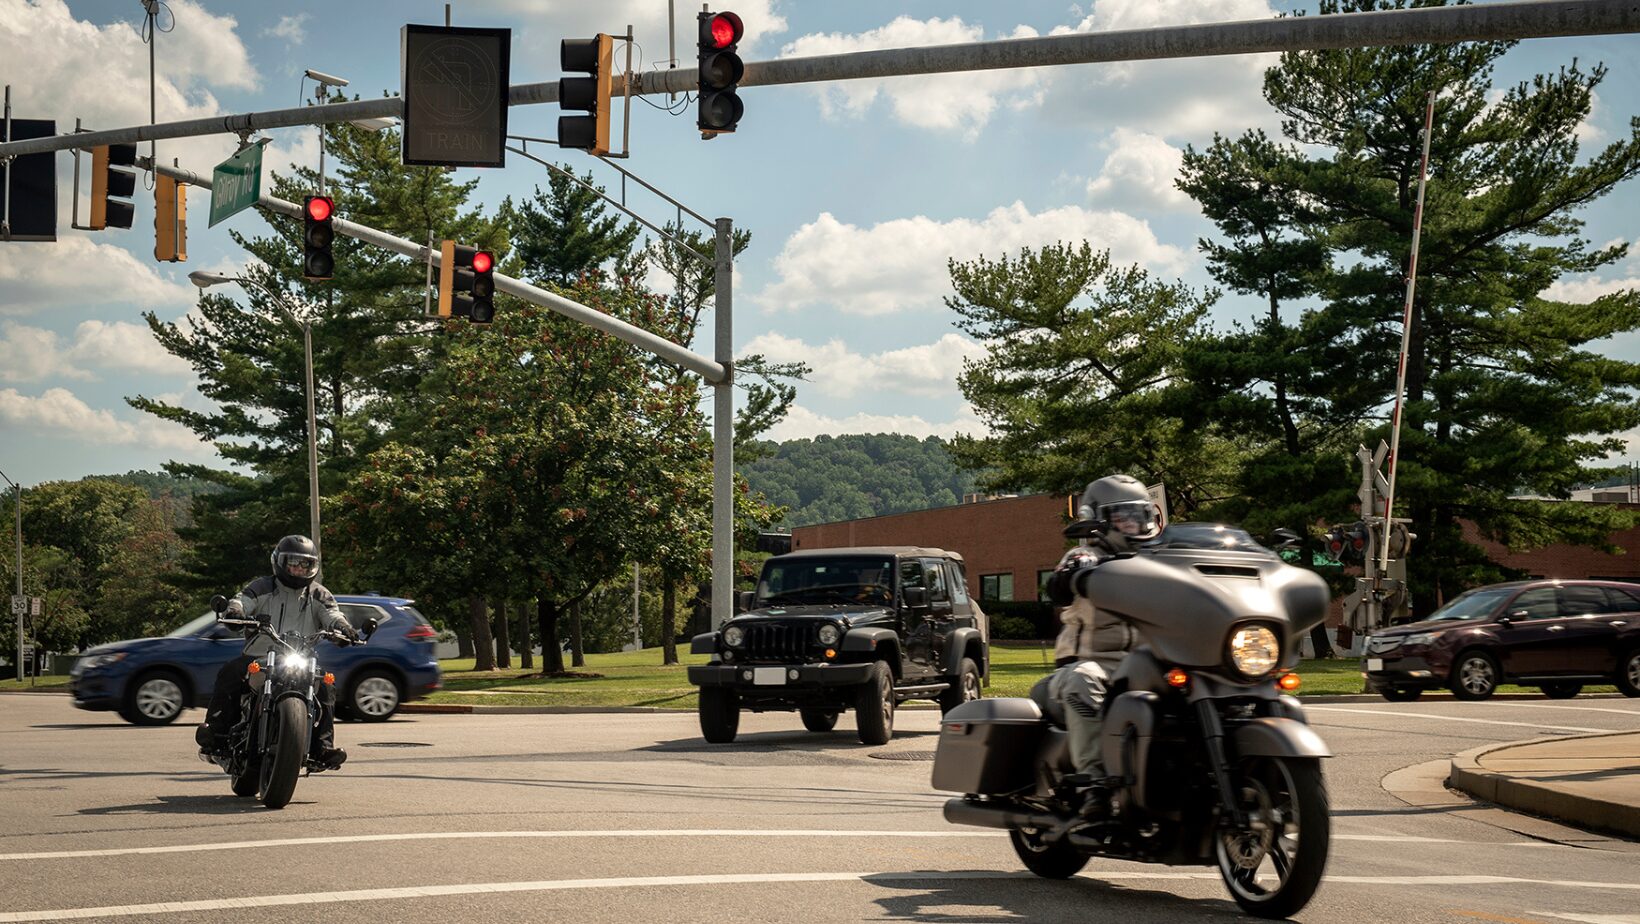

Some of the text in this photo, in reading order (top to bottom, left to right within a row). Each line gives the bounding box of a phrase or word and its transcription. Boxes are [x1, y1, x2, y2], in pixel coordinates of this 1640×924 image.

[426, 132, 483, 150] TRAIN
[241, 161, 256, 196] Rd
[14, 602, 26, 610] 30
